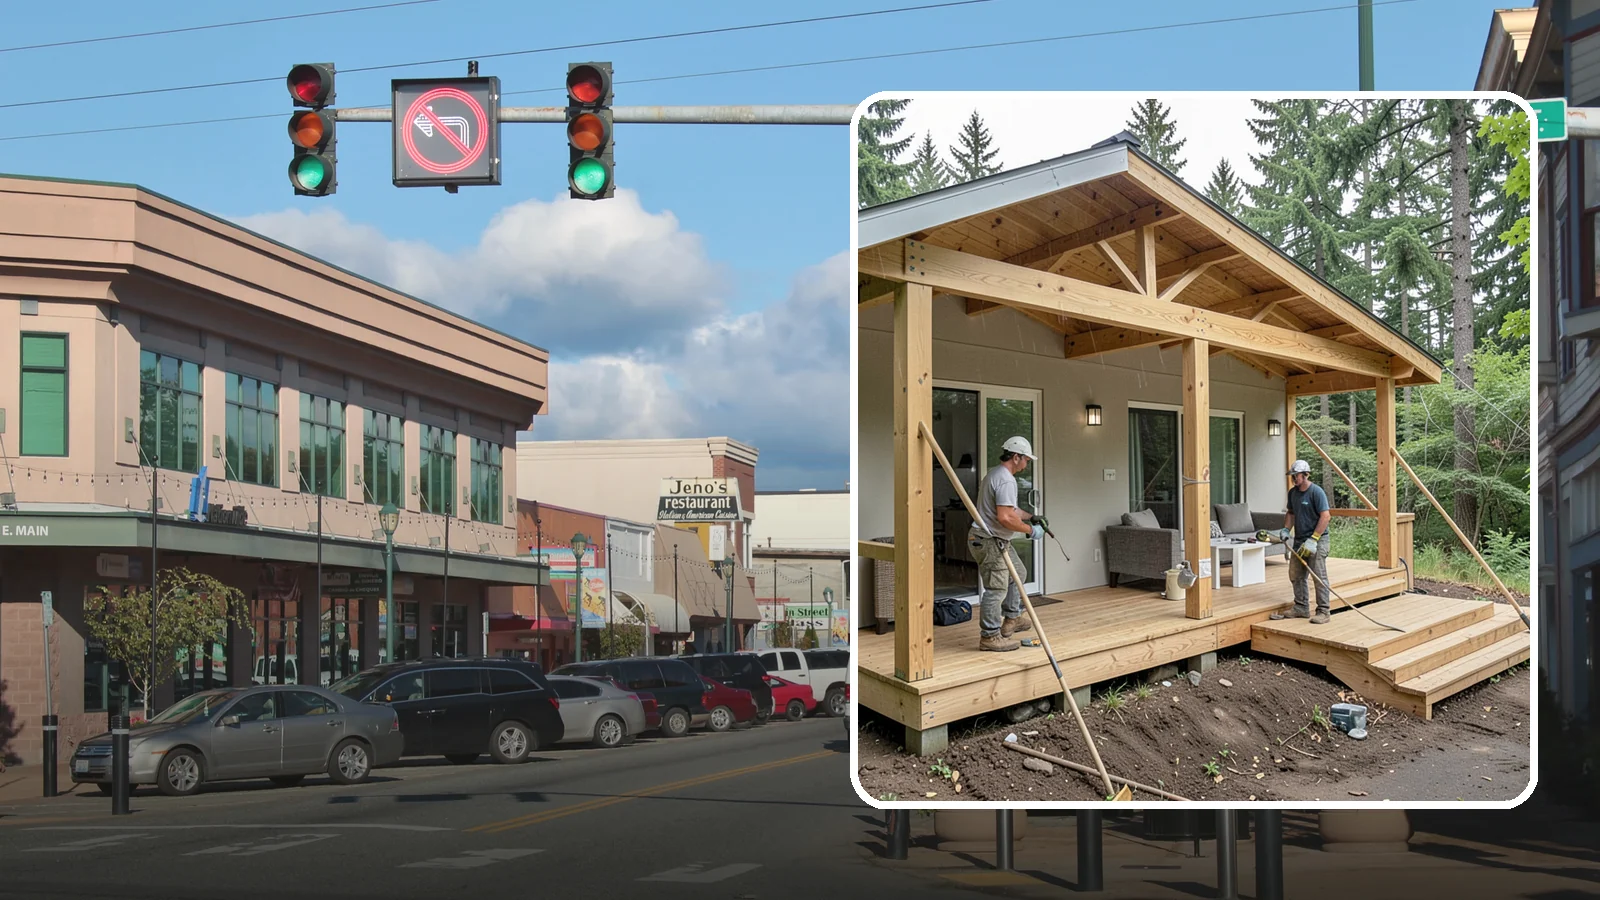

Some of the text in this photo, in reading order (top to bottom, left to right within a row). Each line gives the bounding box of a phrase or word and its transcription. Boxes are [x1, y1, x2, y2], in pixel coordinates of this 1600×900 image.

[669, 480, 727, 495] Jeno's
[665, 496, 731, 509] restaurant
[658, 510, 681, 519] Italian
[686, 510, 715, 519] American
[715, 510, 738, 519] Cuisine
[2, 525, 49, 536] E. MAIN
[797, 607, 829, 617] Street
